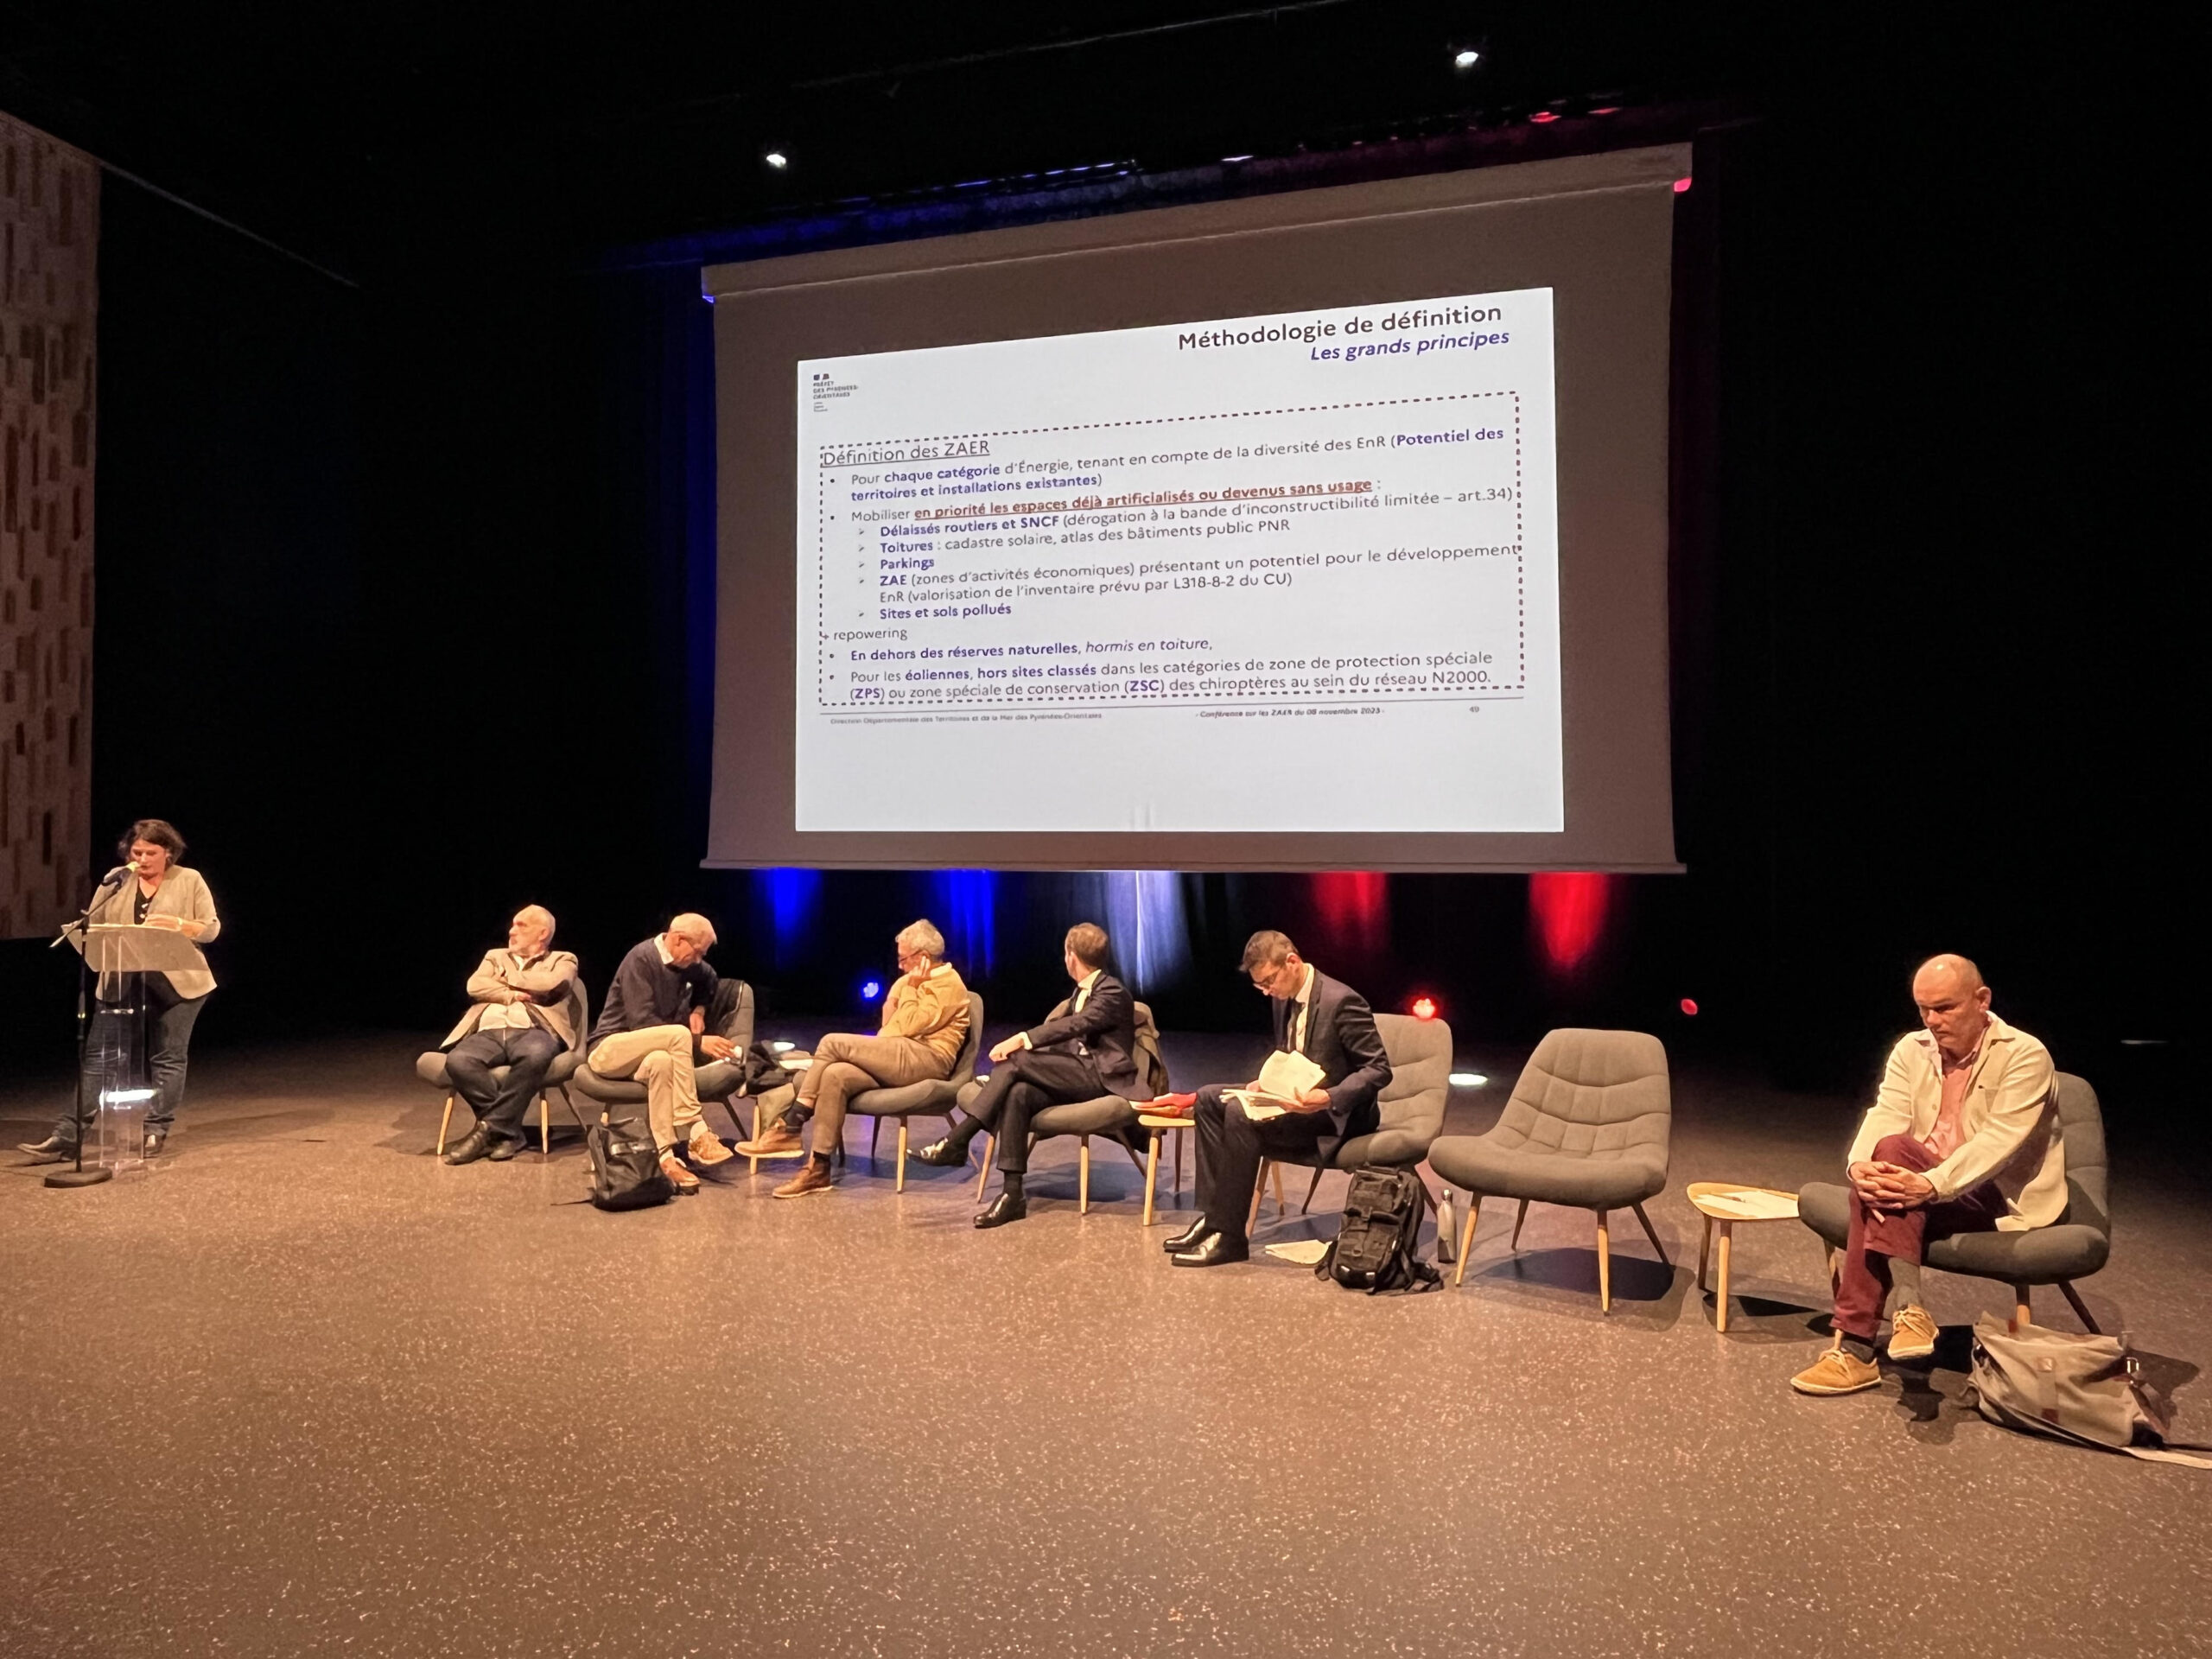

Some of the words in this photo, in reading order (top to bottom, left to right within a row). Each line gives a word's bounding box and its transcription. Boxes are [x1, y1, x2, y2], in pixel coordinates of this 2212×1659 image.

[1179, 323, 1336, 350] Méthodologie
[1344, 318, 1373, 334] de
[1382, 306, 1501, 331] définition
[1311, 346, 1340, 360] Les
[1345, 338, 1411, 361] grands
[1417, 331, 1510, 355] principes
[824, 448, 904, 466] Définition
[911, 445, 938, 459] des
[944, 441, 990, 455] ZAER
[852, 474, 880, 485] Pour
[885, 471, 932, 483] chaque
[937, 463, 1000, 480] catégorie
[1077, 457, 1124, 469] tenant
[1129, 456, 1147, 465] en
[1152, 451, 1209, 465] compte
[1213, 448, 1232, 459] de
[1237, 446, 1249, 457] la
[1255, 441, 1319, 456] diversité
[1325, 439, 1351, 451] des
[1357, 435, 1385, 448] EnR
[1391, 429, 1469, 448] (Potentiel
[1475, 428, 1503, 440] des
[851, 487, 917, 501] territoires
[920, 486, 934, 496] et
[938, 480, 1021, 495] installations
[1026, 474, 1102, 489] existantes)
[852, 509, 910, 521] Mobiliser
[914, 508, 930, 518] en
[935, 503, 986, 519] priorité
[990, 501, 1009, 513] les
[1013, 499, 1067, 514] espaces
[1071, 495, 1103, 511] déjà
[1106, 487, 1194, 505] artificialisés
[1198, 489, 1217, 500] ou
[1222, 486, 1285, 499] devenus
[1289, 483, 1324, 494] sans
[1328, 480, 1372, 494] usage
[880, 523, 940, 537] Délaissés
[944, 520, 997, 533] routiers
[1001, 519, 1016, 530] et
[1020, 516, 1059, 528] SNCF
[1064, 511, 1146, 528] (dérogation
[1151, 509, 1158, 521] à
[1164, 509, 1174, 519] la
[1180, 505, 1227, 518] bande
[1385, 493, 1439, 506] limitée
[1459, 487, 1512, 502] art.34)
[880, 542, 933, 553] Toitures
[945, 537, 1003, 550] cadastre
[1007, 533, 1057, 546] solaire,
[1061, 531, 1094, 543] atlas
[1098, 530, 1123, 541] des
[1128, 526, 1202, 539] bâtiments
[1207, 521, 1253, 538] public
[1259, 519, 1290, 531] PNR
[880, 557, 934, 570] Parkings
[880, 575, 907, 587] ZAE
[912, 574, 954, 587] (zones
[1034, 563, 1134, 578] économiques)
[1140, 560, 1220, 576] présentant
[1225, 560, 1243, 569] un
[1250, 553, 1319, 571] potentiel
[1325, 554, 1362, 567] pour
[1369, 550, 1381, 562] le
[1387, 544, 1517, 561] développement
[880, 591, 904, 602] EnR
[908, 588, 990, 603] (valorisation
[995, 587, 1013, 598] de
[1099, 581, 1140, 595] prévu
[1145, 582, 1168, 593] par
[1174, 575, 1234, 589] L318-8-2
[1240, 575, 1258, 586] du
[1264, 573, 1292, 587] CU)
[880, 608, 911, 620] Sites
[915, 608, 929, 618] et
[933, 606, 958, 617] sols
[963, 603, 1011, 620] pollués
[834, 627, 907, 643] repowering
[851, 651, 866, 661] En
[870, 649, 916, 660] dehors
[920, 647, 944, 658] des
[948, 646, 1003, 658] réserves
[1008, 643, 1081, 655] naturelles,
[1086, 640, 1134, 652] hormis
[1138, 642, 1154, 651] en
[1160, 639, 1212, 650] toiture,
[851, 671, 880, 683] Pour
[884, 671, 901, 682] les
[906, 669, 973, 681] éoliennes,
[977, 667, 1007, 678] hors
[1012, 665, 1043, 677] sites
[1047, 664, 1096, 677] classés
[1101, 664, 1135, 675] dans
[1141, 662, 1159, 674] les
[1163, 659, 1240, 676] catégories
[1245, 658, 1264, 671] de
[1269, 660, 1306, 670] zone
[1311, 657, 1330, 669] de
[1336, 654, 1420, 671] protection
[1427, 652, 1492, 669] spéciale
[850, 688, 885, 701] (ZPS)
[889, 690, 906, 698] ou
[910, 689, 942, 697] zone
[946, 684, 1001, 699] spéciale
[1006, 684, 1022, 695] de
[1027, 681, 1119, 694] conservation
[1125, 679, 1164, 694] (ZSC)
[1169, 678, 1195, 690] des
[1199, 676, 1286, 692] chiroptères
[1291, 678, 1308, 688] au
[1313, 674, 1344, 687] sein
[1350, 674, 1370, 686] du
[1376, 672, 1427, 685] réseau
[1433, 671, 1491, 683] N2000.
